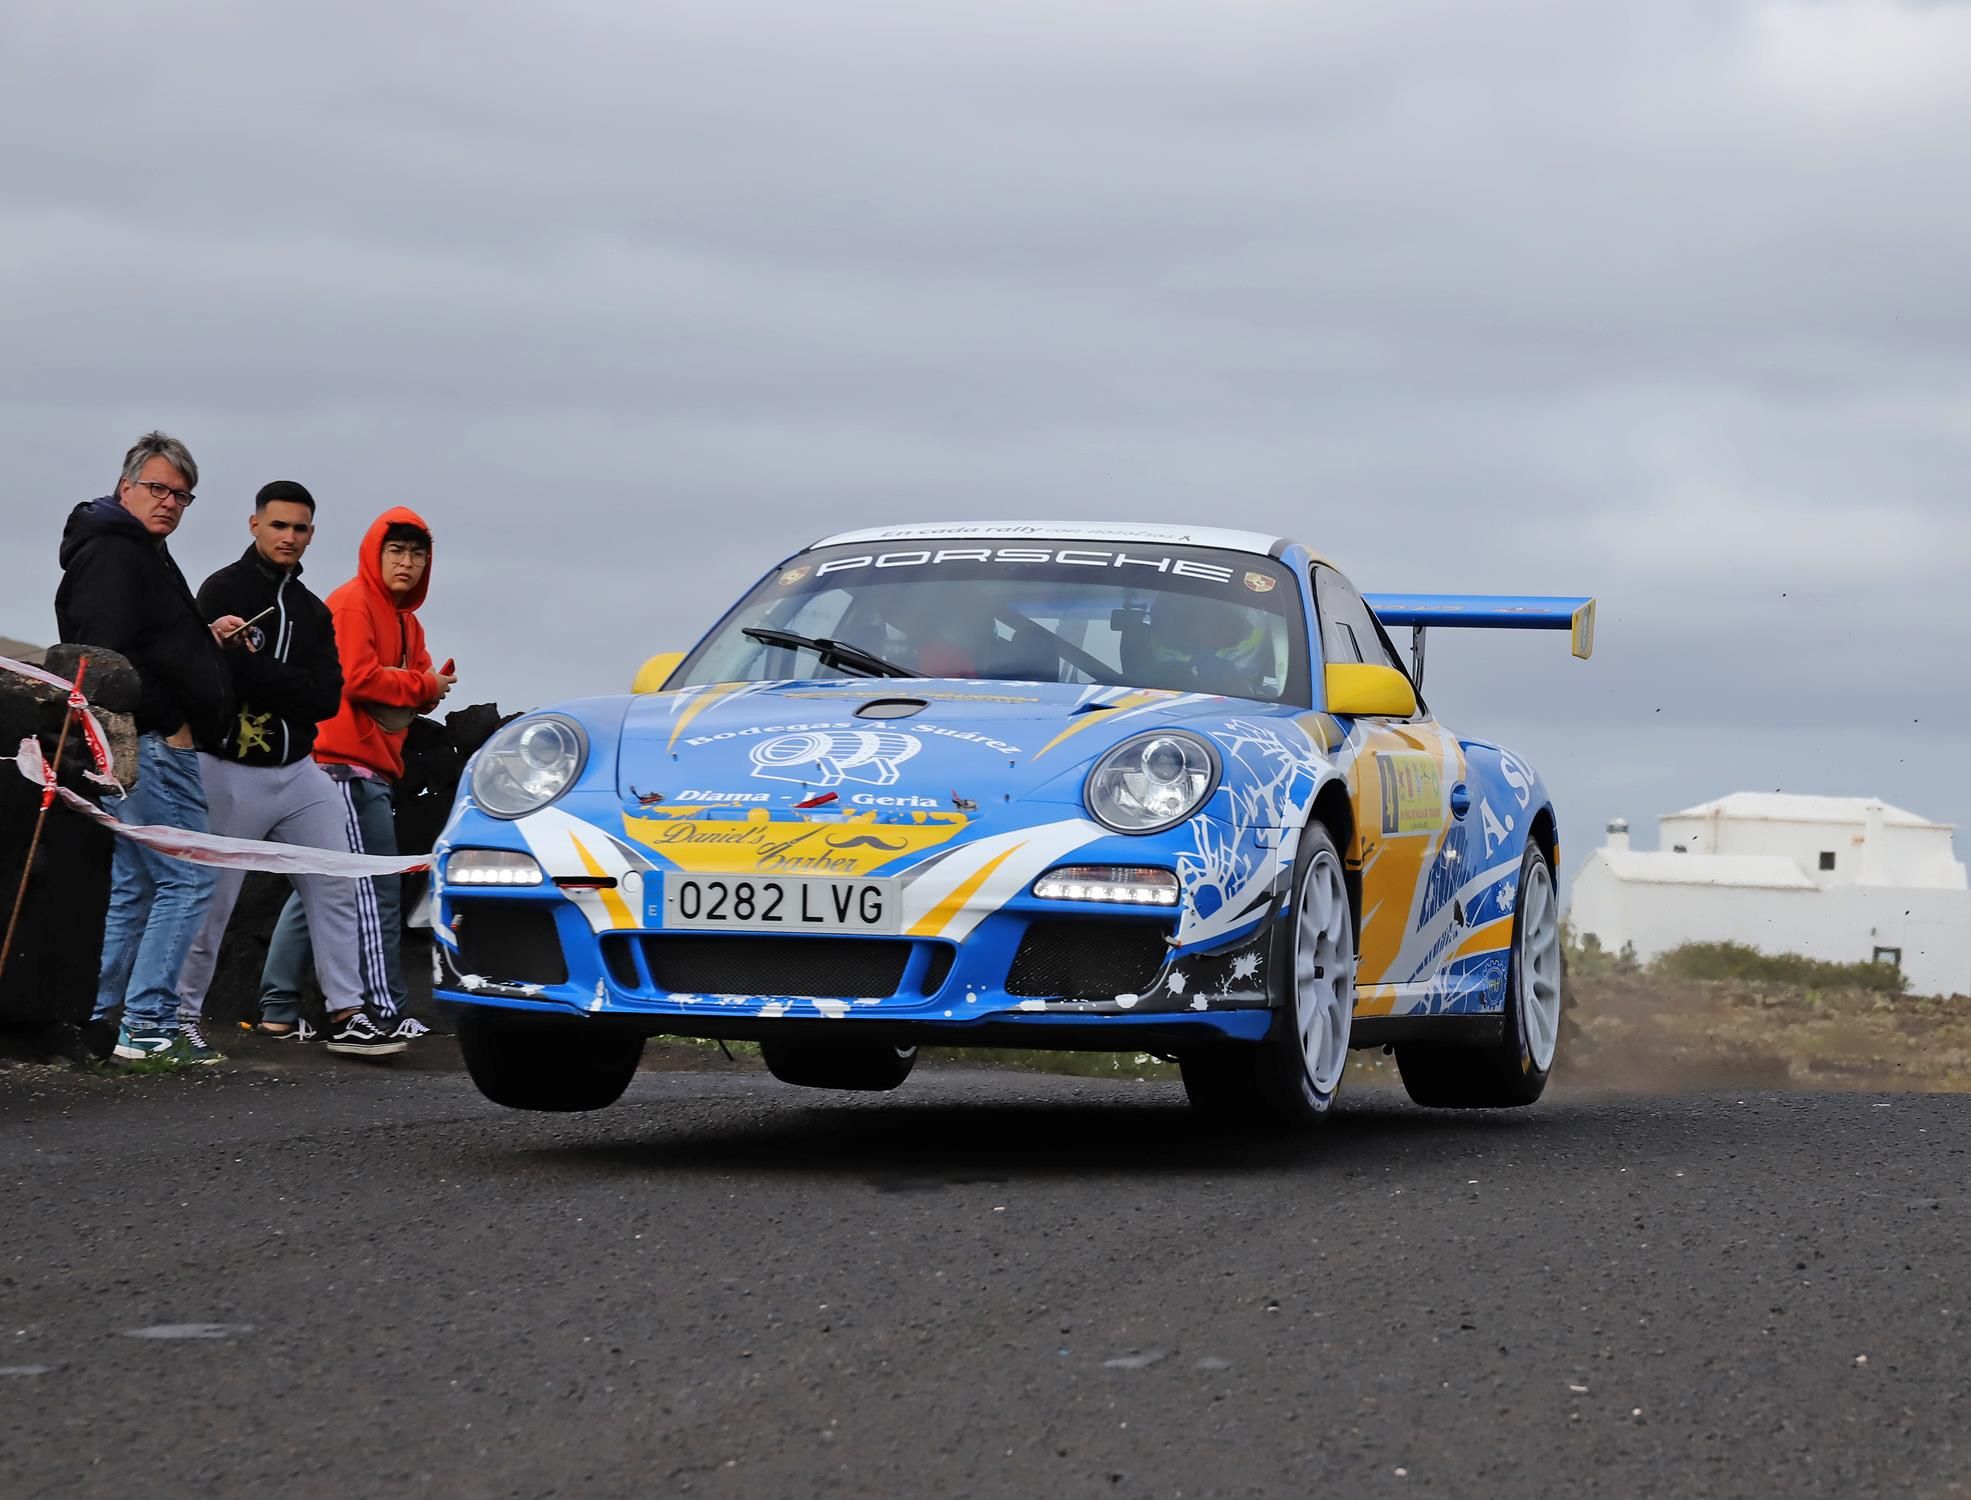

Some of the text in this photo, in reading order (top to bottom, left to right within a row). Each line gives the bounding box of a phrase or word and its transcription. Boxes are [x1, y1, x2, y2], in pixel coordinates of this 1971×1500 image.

[918, 526, 978, 535] cada
[985, 525, 1045, 535] rally
[815, 548, 1234, 584] PORSCHE
[684, 721, 1024, 754] Bodegas A. Suárez
[674, 789, 770, 803] Diama
[851, 792, 939, 808] Geria
[653, 821, 769, 845] Daniel's
[679, 880, 884, 926] 0282 LVG
